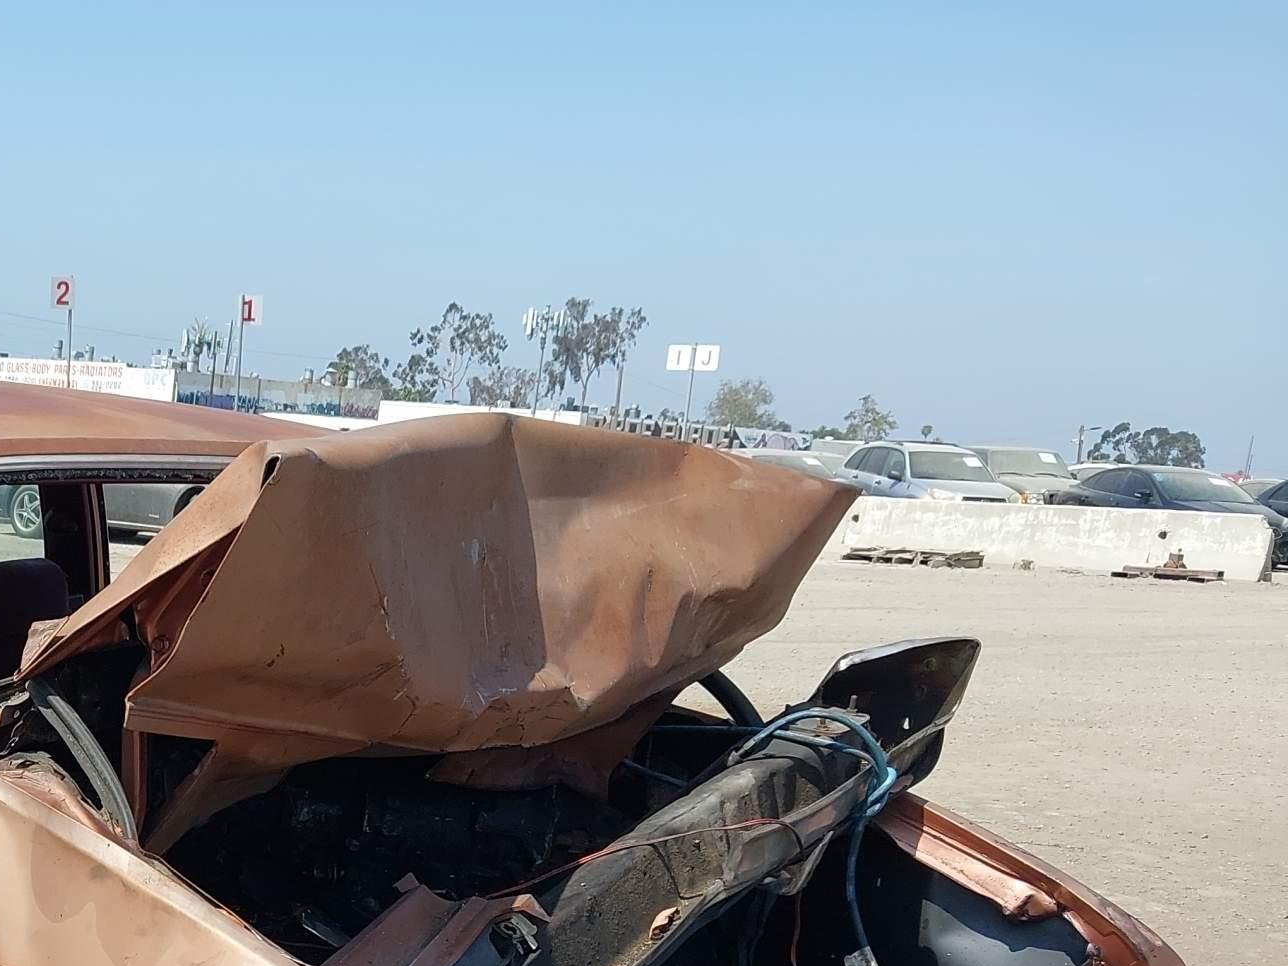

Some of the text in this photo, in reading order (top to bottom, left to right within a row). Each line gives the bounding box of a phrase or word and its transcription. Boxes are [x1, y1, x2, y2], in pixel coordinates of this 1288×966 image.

[56, 281, 69, 305] 2
[243, 299, 255, 322] 1
[676, 350, 712, 366] I J
